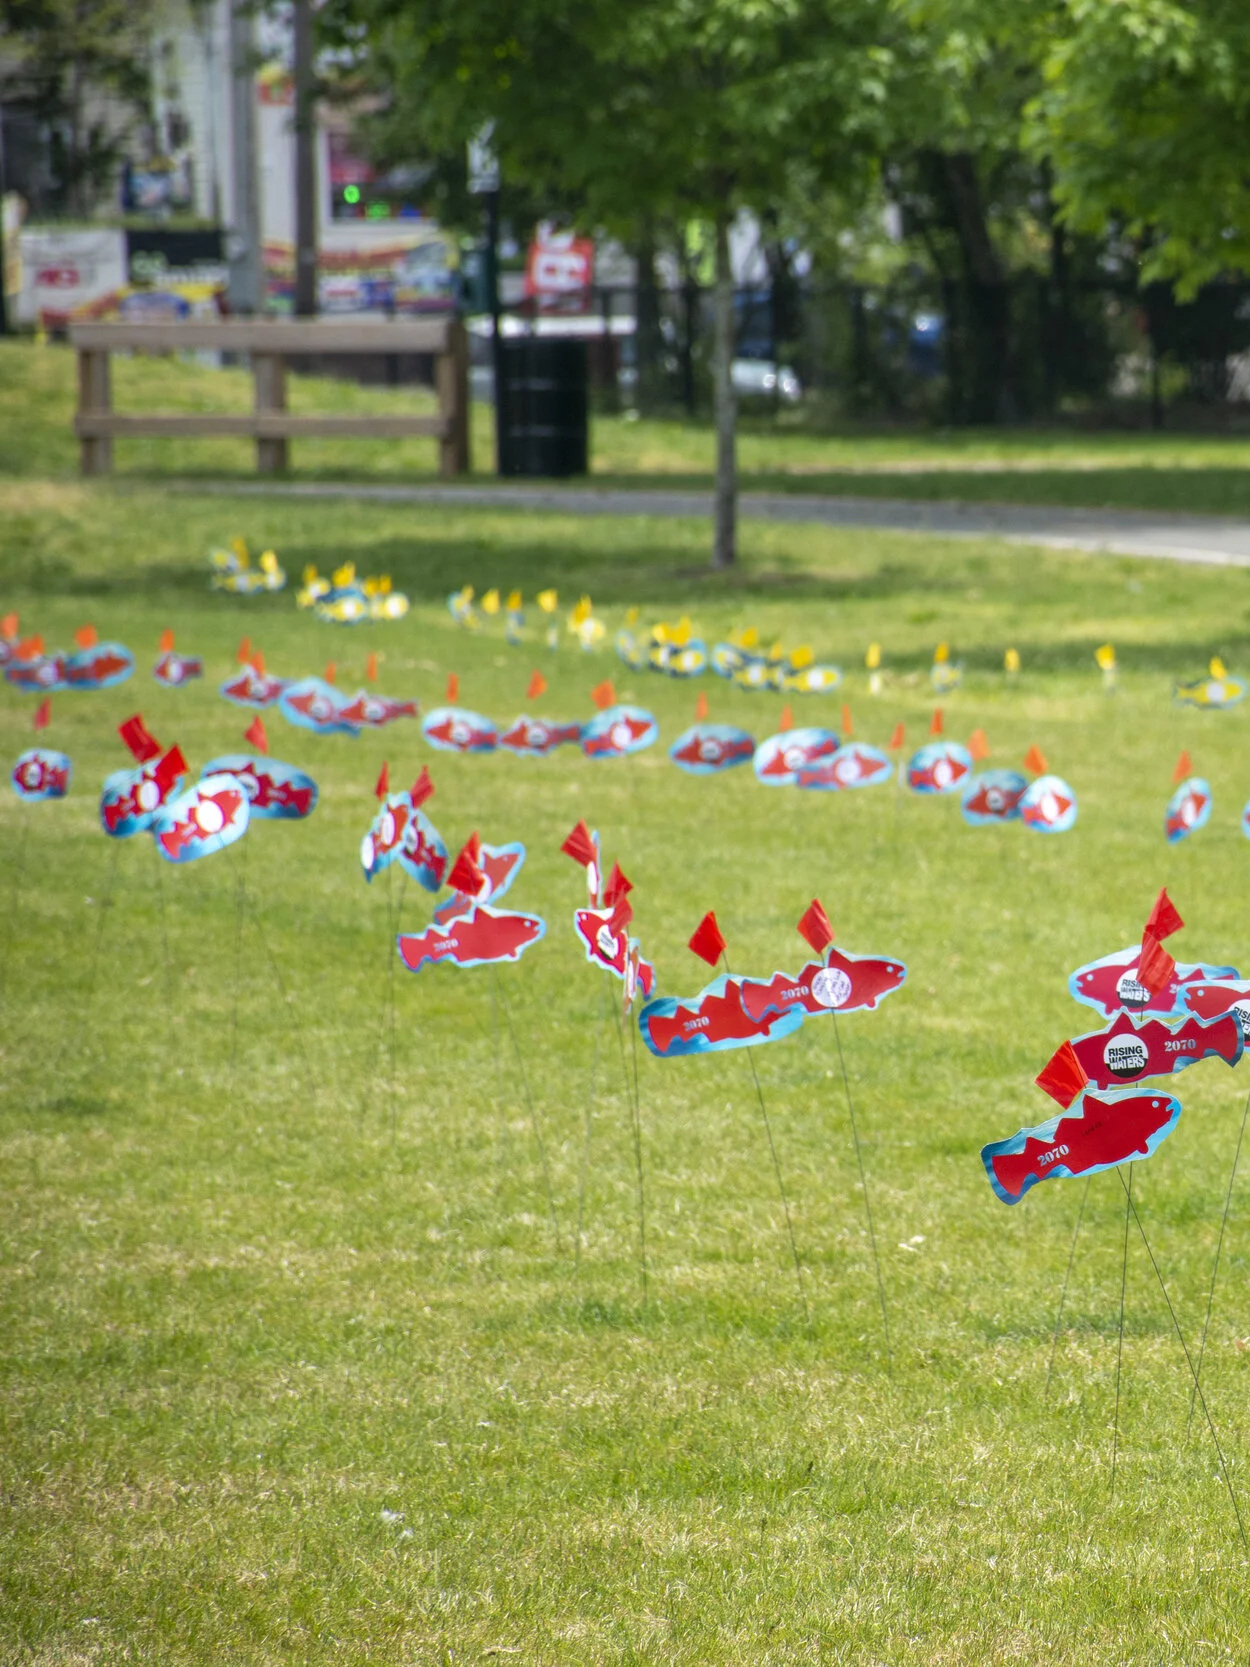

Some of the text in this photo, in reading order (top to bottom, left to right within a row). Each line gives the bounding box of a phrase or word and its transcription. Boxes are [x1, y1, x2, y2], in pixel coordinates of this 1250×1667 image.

[781, 985, 809, 999] 2070
[683, 1016, 710, 1032] 2070
[1108, 1045, 1143, 1057] RISING
[1164, 1038, 1197, 1052] 2070
[1109, 1054, 1145, 1071] WATERS
[1037, 1144, 1070, 1167] 2070
